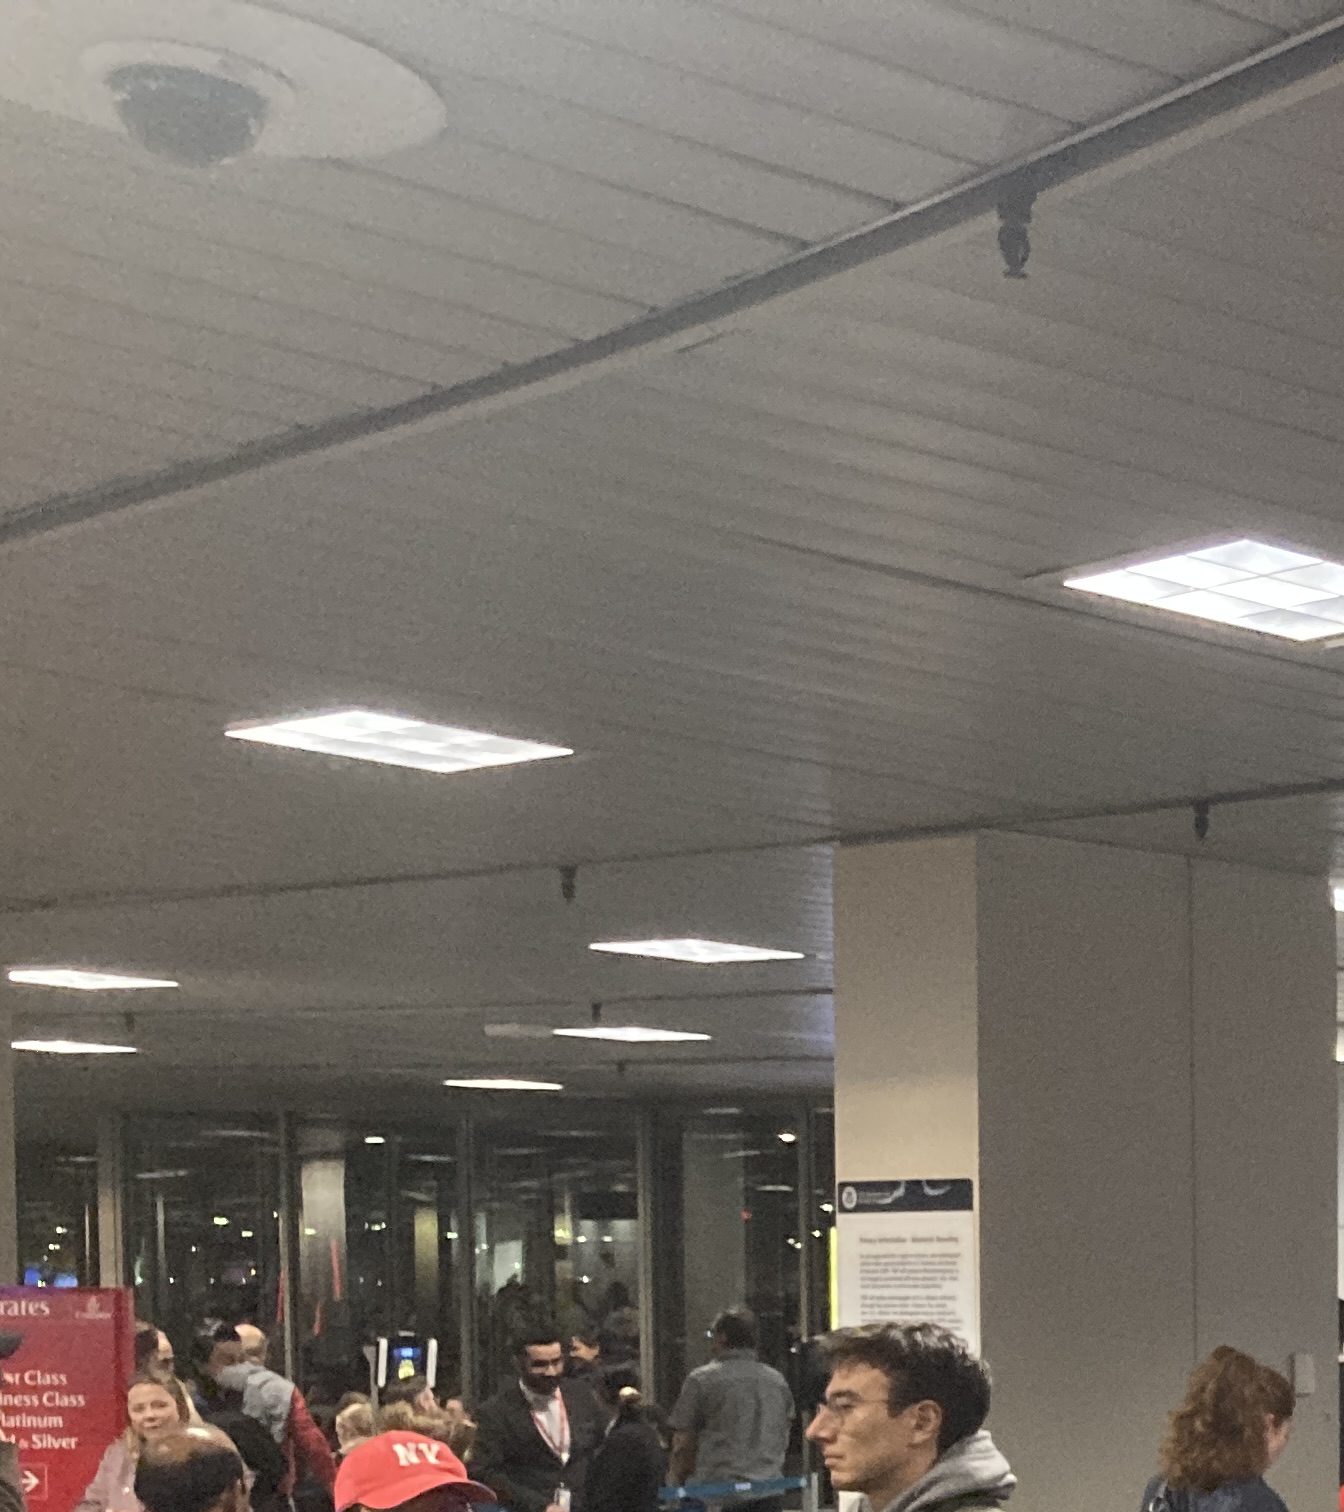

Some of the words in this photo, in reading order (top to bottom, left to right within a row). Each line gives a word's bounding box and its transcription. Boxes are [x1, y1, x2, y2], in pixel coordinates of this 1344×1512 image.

[24, 1369, 67, 1386] Class
[42, 1391, 85, 1407] Class
[31, 1433, 78, 1450] Silver
[392, 1442, 441, 1467] NY
